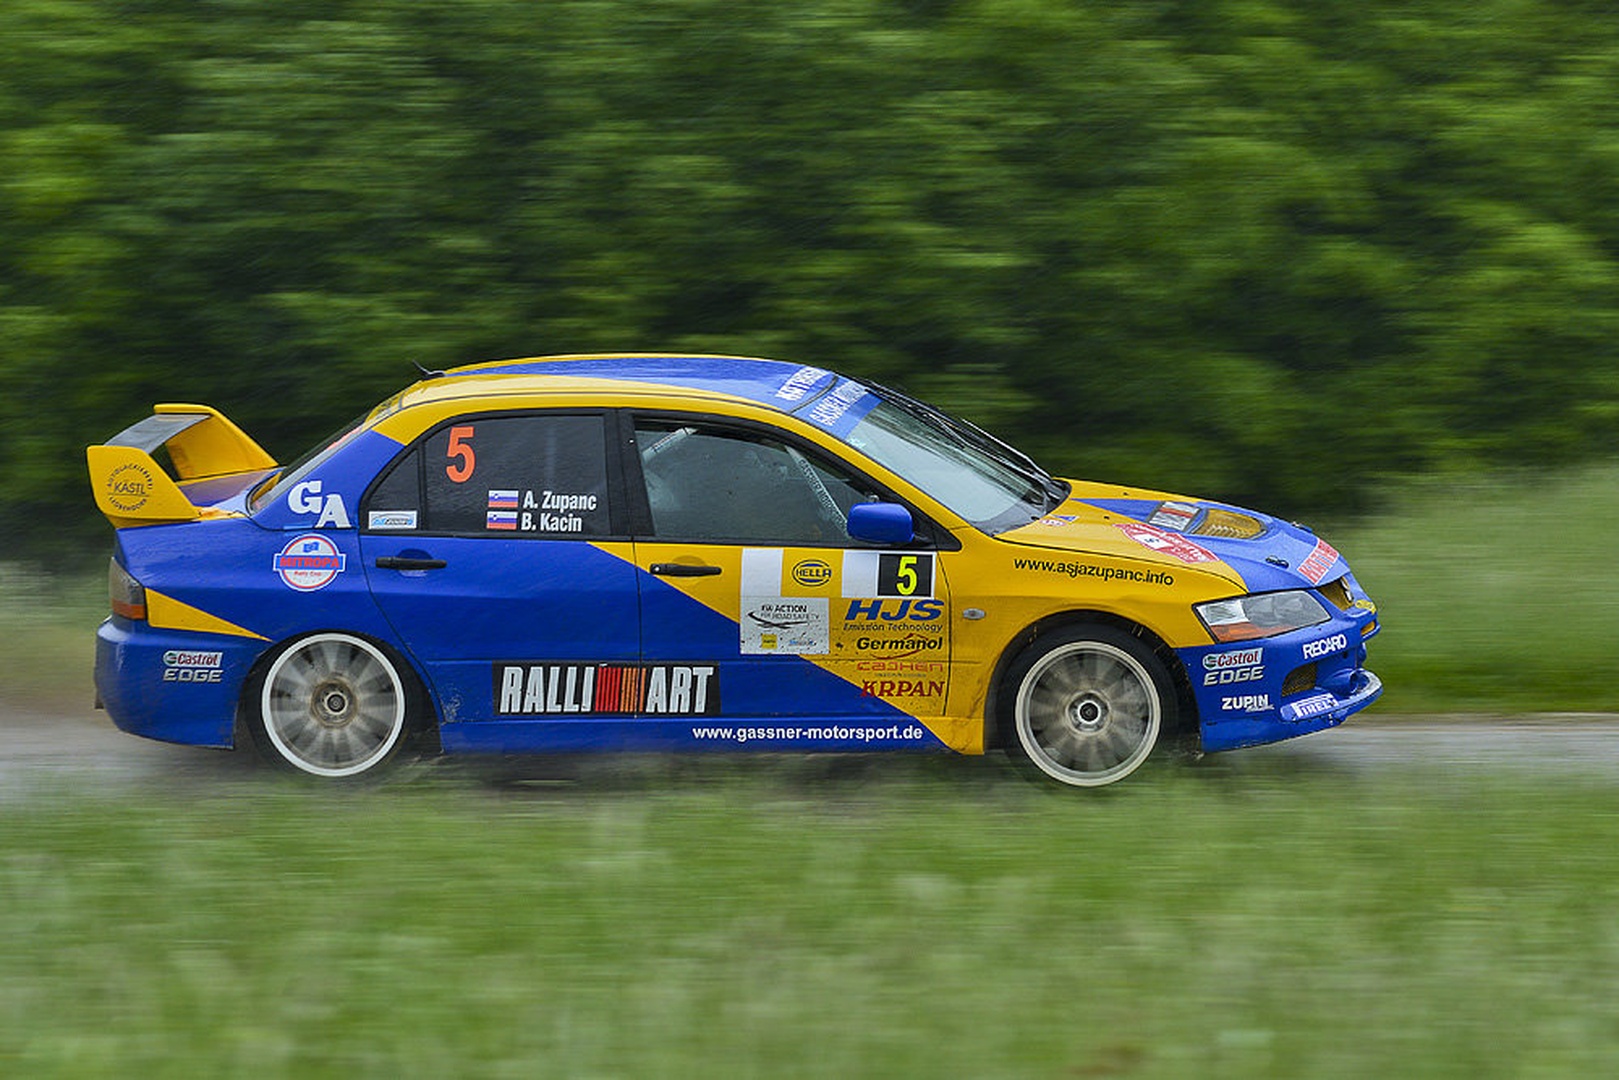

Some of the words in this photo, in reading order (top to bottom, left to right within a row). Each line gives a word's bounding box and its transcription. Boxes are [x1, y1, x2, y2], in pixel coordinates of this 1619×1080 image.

[446, 426, 476, 483] 5
[114, 482, 146, 495] KASTL
[522, 490, 539, 509] A.
[541, 490, 597, 513] Zupanc
[520, 512, 537, 531] B.
[540, 513, 582, 532] Kacin
[279, 557, 340, 568] MITROPA
[796, 567, 832, 578] HELLA
[896, 556, 917, 595] 5
[1014, 558, 1174, 586] www.asjazupanc.info
[775, 604, 807, 613] ACTION
[844, 599, 944, 620] HJS
[843, 623, 884, 631] Emission
[888, 623, 943, 633] Technology
[857, 636, 943, 650] Germanol
[1303, 634, 1347, 659] RECARO
[178, 653, 218, 666] Castrol
[1218, 650, 1259, 667] Castrol
[163, 668, 224, 682] EDGE
[1203, 665, 1266, 687] EDGE
[861, 679, 945, 697] KRPAN
[1222, 694, 1269, 710] ZUPIN
[692, 727, 923, 742] www.gassner-motorsport.de
